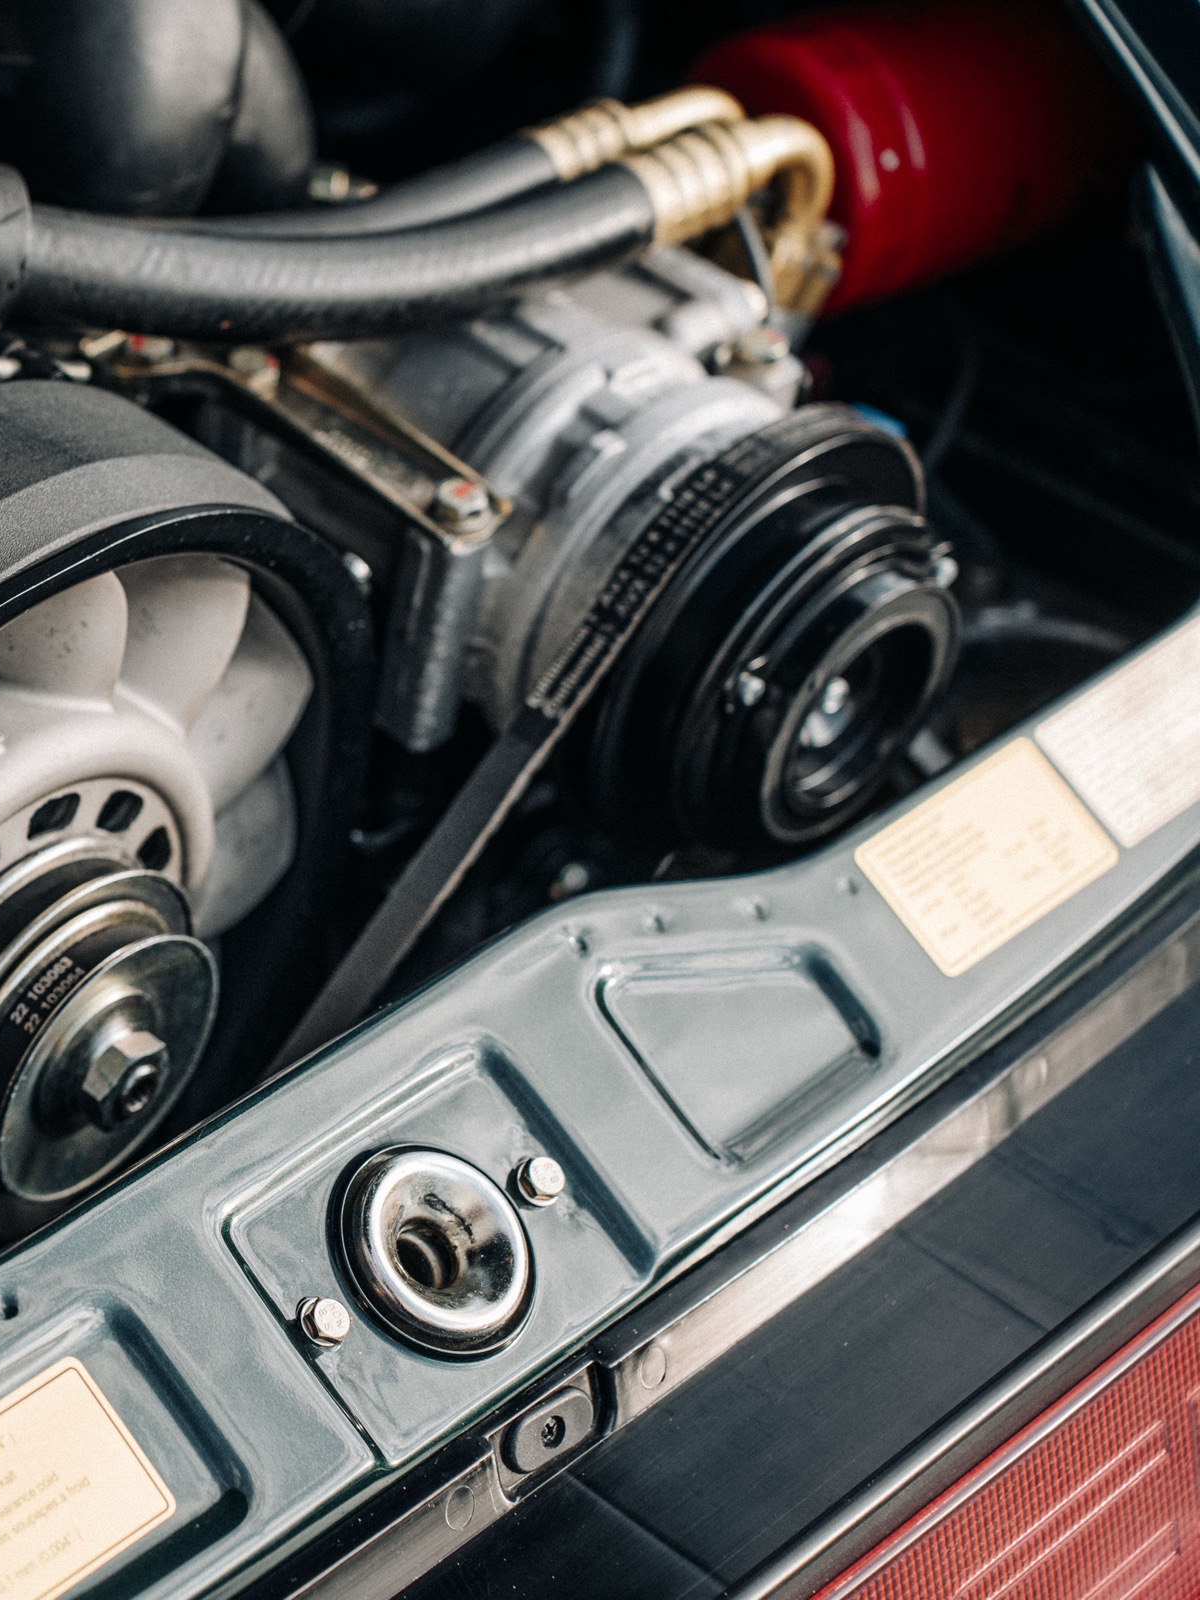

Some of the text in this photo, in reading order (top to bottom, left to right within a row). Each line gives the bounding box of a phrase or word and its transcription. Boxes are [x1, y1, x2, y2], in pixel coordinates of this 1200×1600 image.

[10, 1003, 30, 1025] 22
[23, 1013, 41, 1034] 22
[36, 1471, 59, 1491] cold
